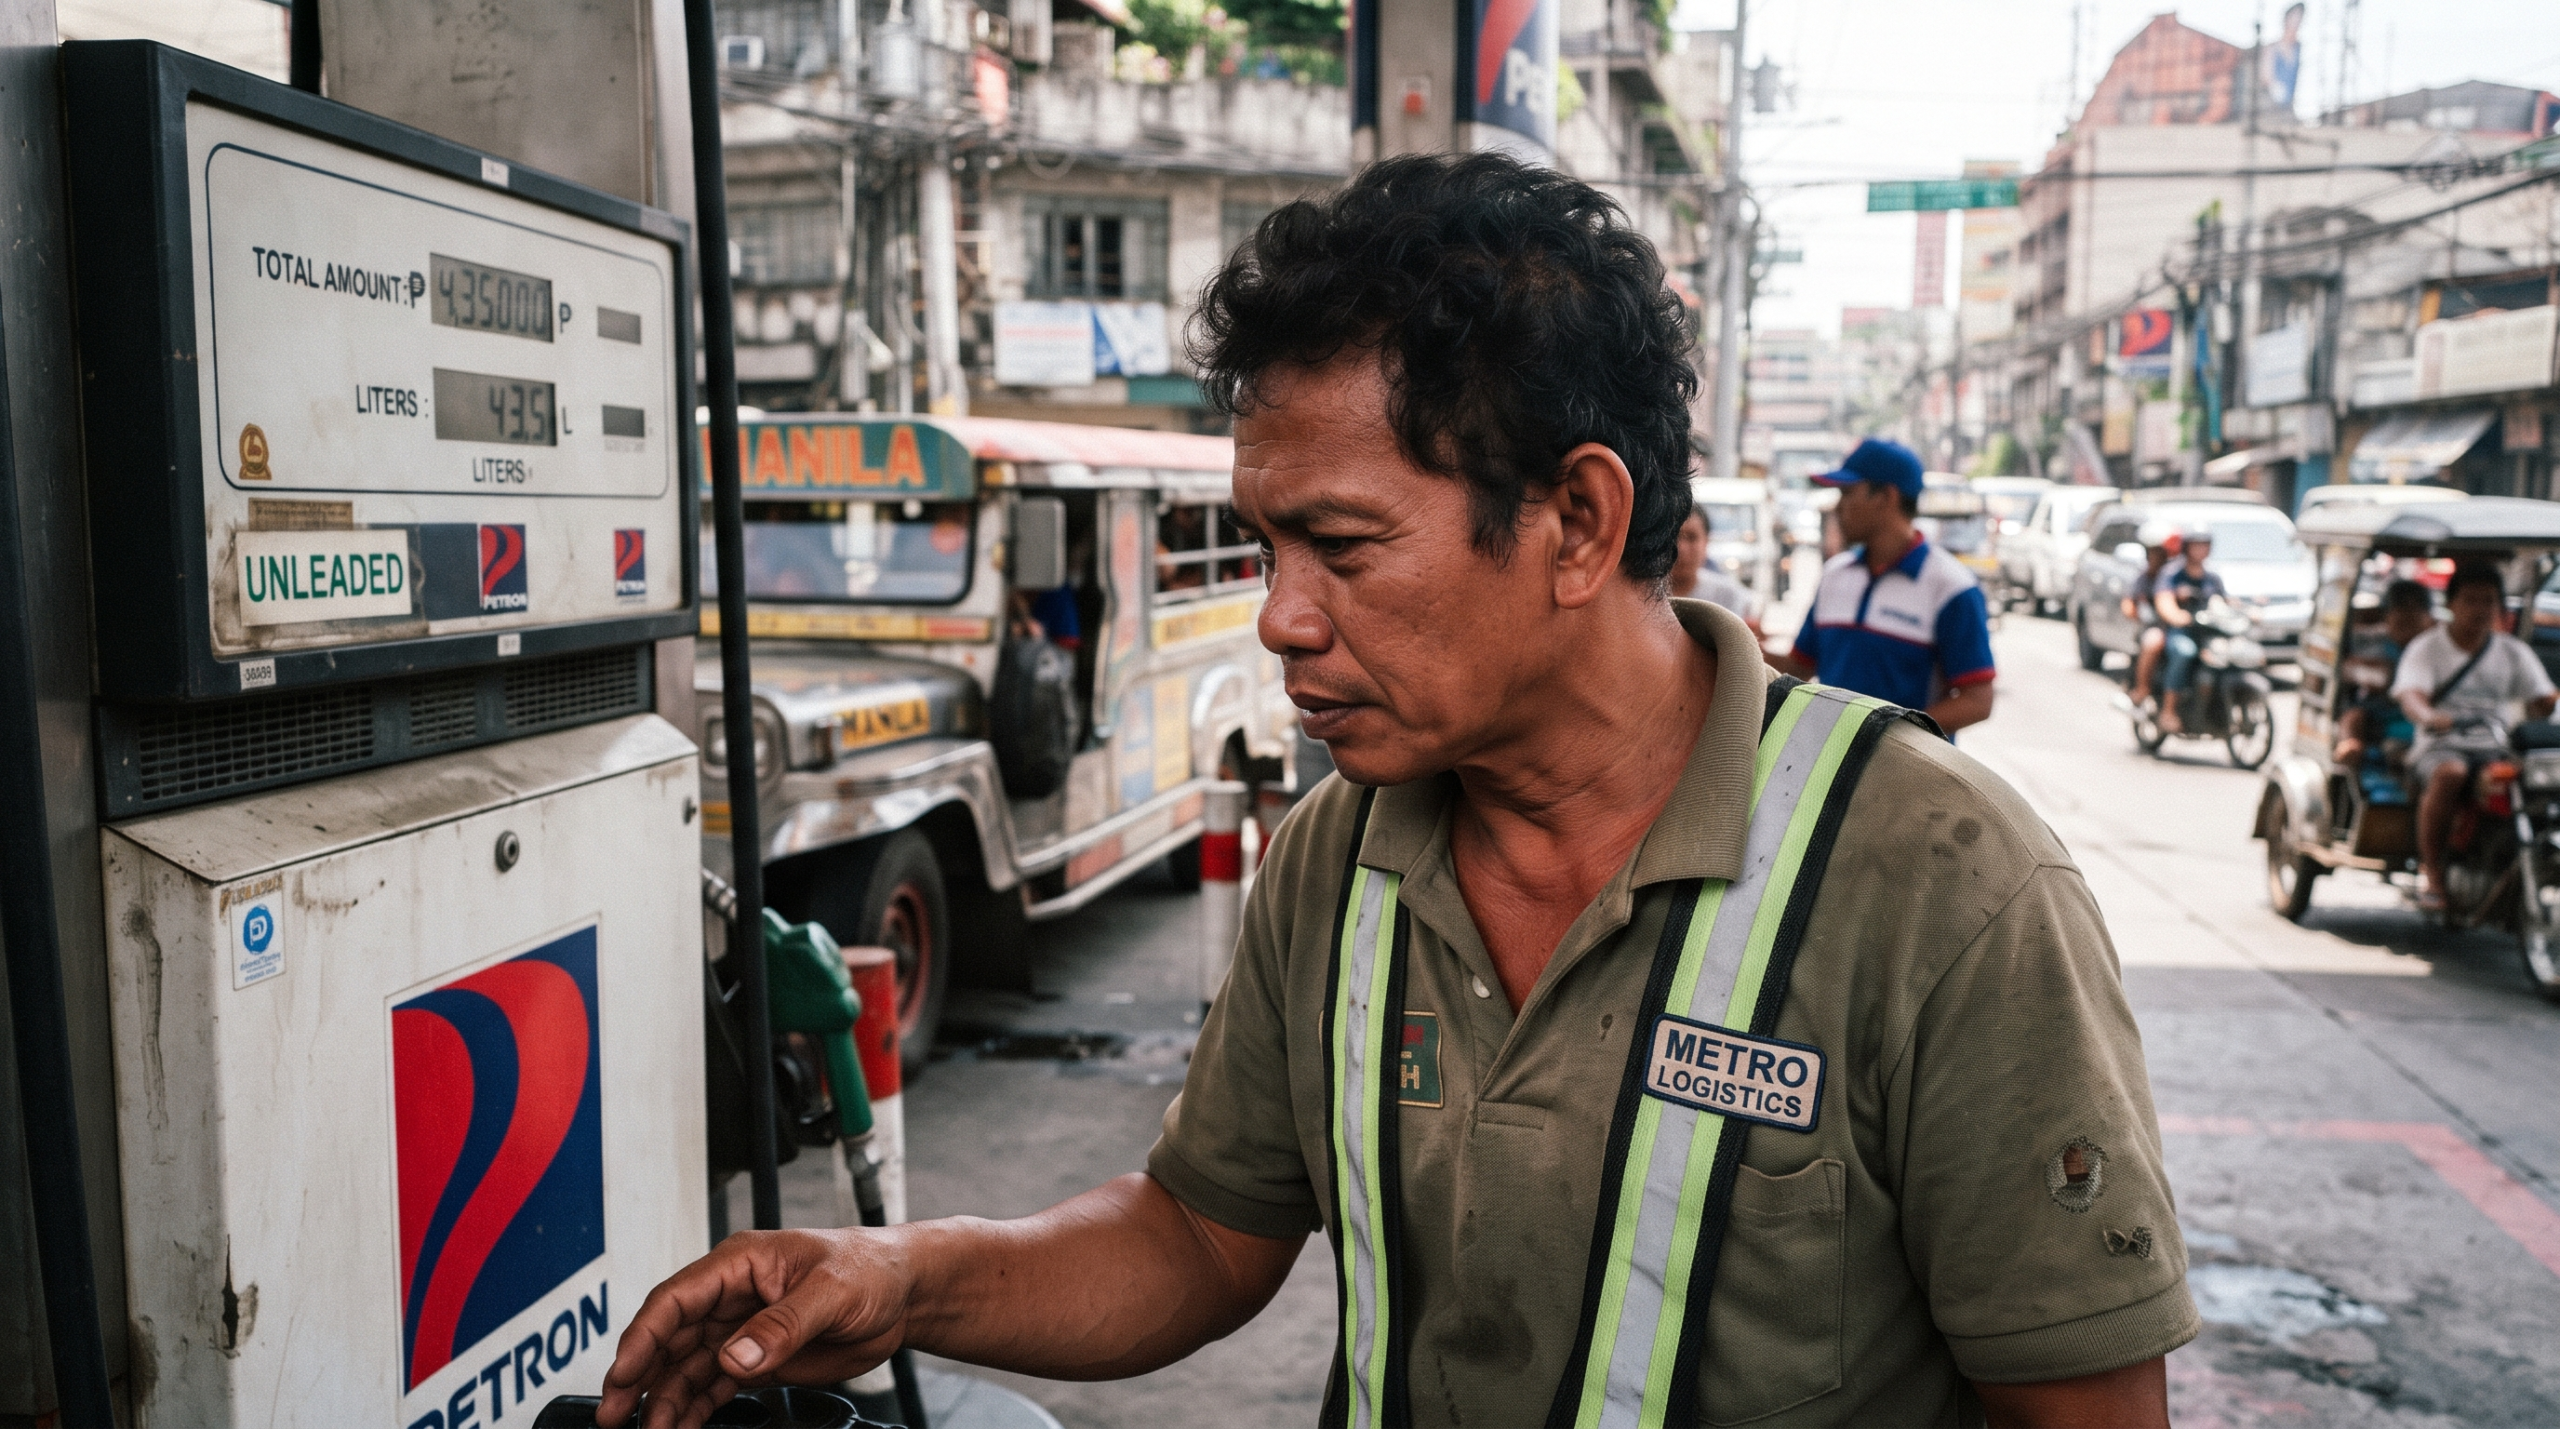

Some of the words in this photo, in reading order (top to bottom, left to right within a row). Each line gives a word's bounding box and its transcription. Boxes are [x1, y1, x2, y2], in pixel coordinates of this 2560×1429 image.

[252, 246, 320, 289] TOTAL
[562, 406, 573, 434] L
[246, 553, 403, 602] UNLEADED
[483, 592, 527, 610] PETRON
[1664, 1029, 1808, 1088] METRO
[1656, 1065, 1802, 1118] LOGISTICS
